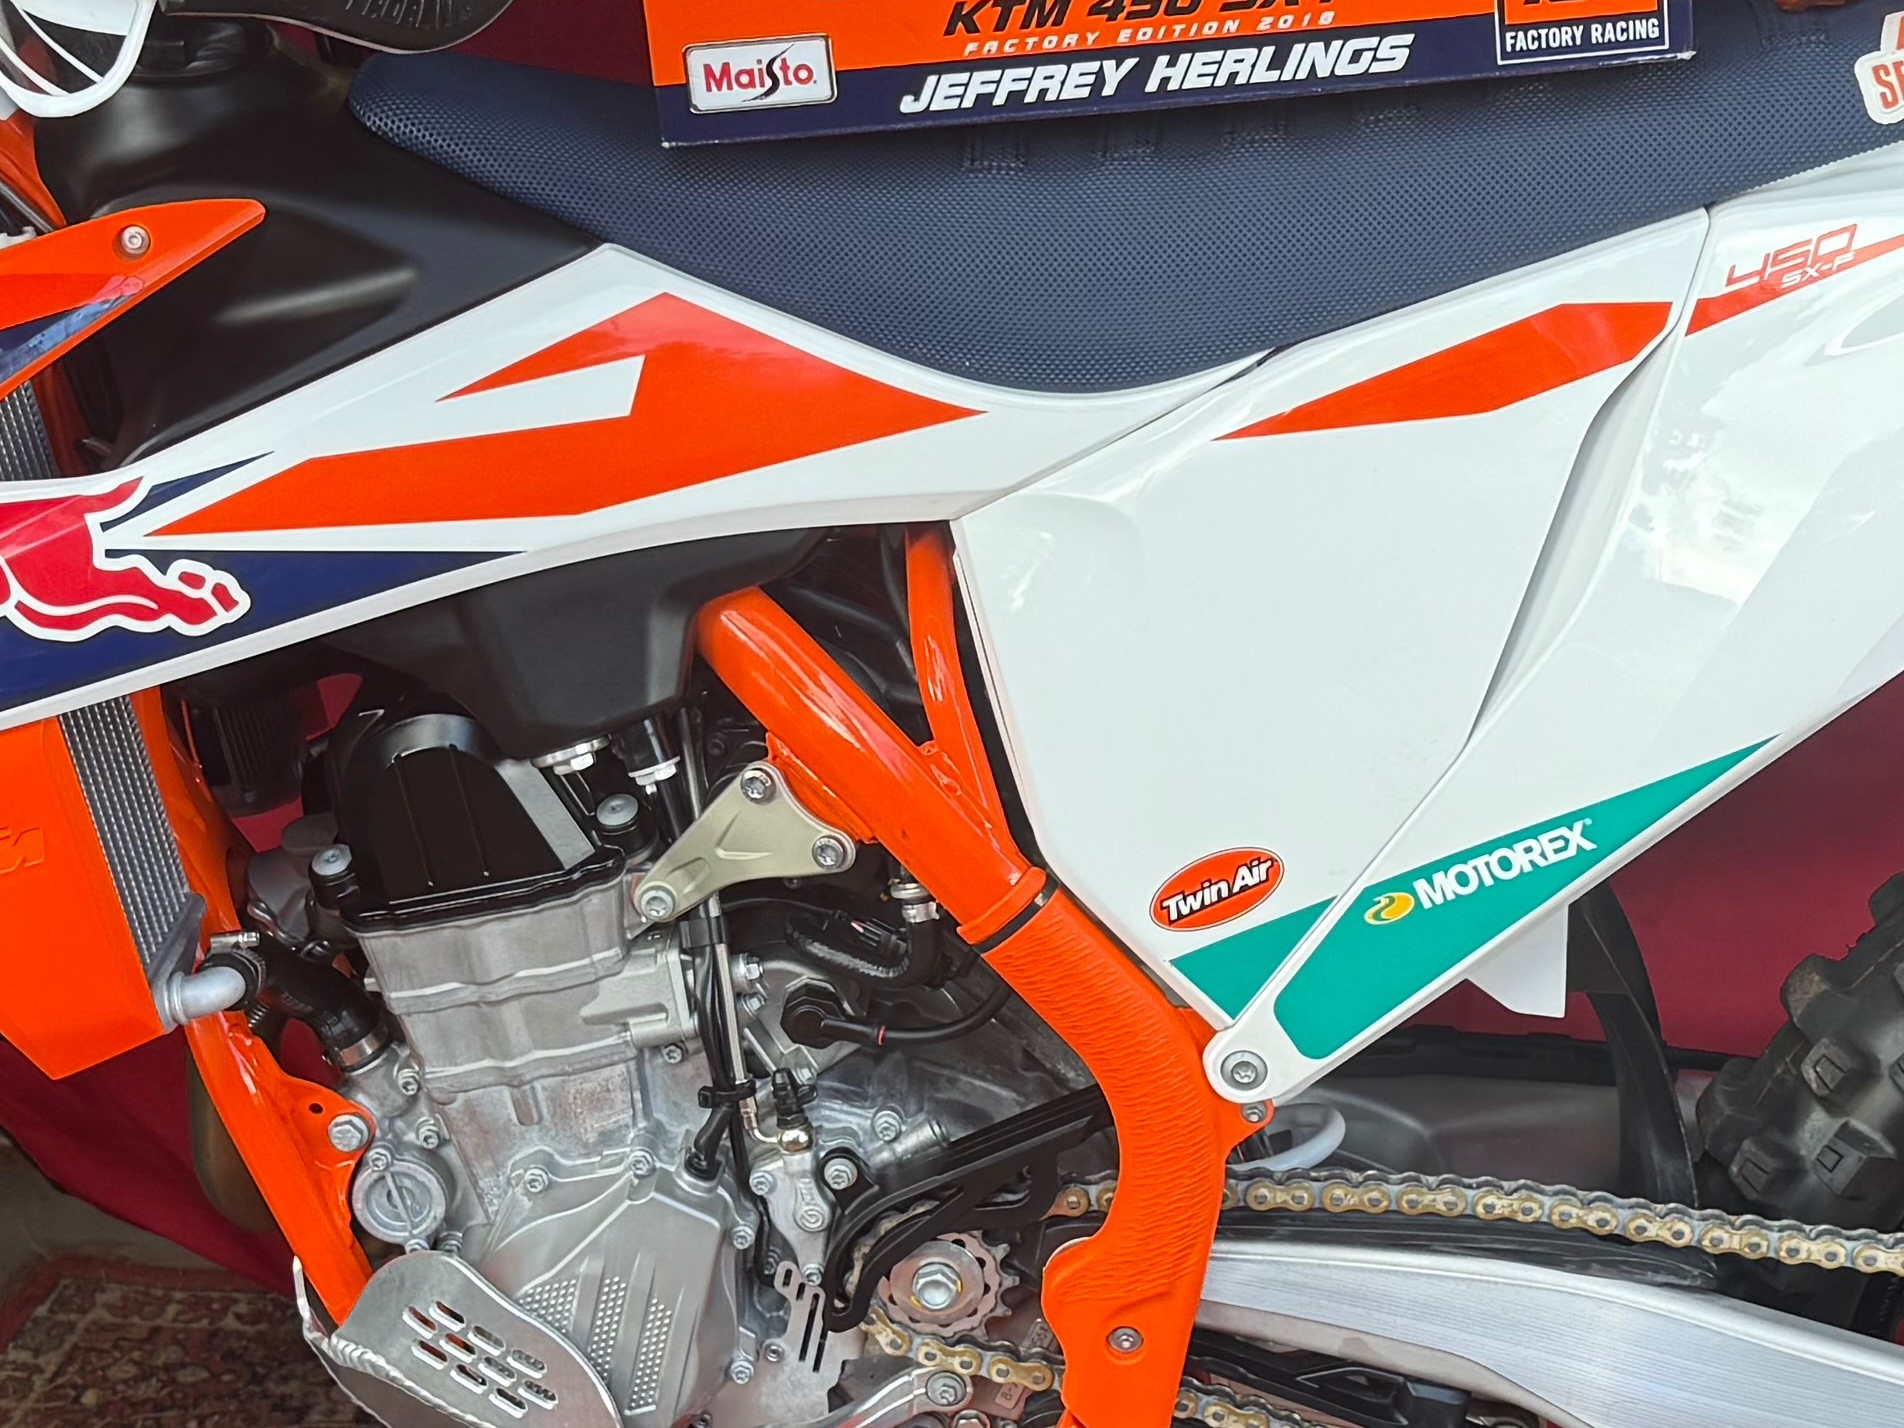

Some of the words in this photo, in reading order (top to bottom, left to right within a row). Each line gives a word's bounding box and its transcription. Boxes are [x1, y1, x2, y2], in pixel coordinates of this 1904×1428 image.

[963, 31, 1100, 59] FACTORY
[1117, 18, 1241, 45] EDITION
[1506, 25, 1584, 53] FACTORY
[1591, 18, 1659, 45] RACING
[702, 43, 816, 103] Maisto
[899, 56, 1139, 114] JEFFREY
[1144, 32, 1415, 94] HERLINGS
[1725, 224, 1858, 287] 450
[1781, 250, 1856, 289] SX-F
[1161, 880, 1228, 926] Twin
[1231, 857, 1278, 895] Air
[1413, 819, 1598, 910] MOTOREX
